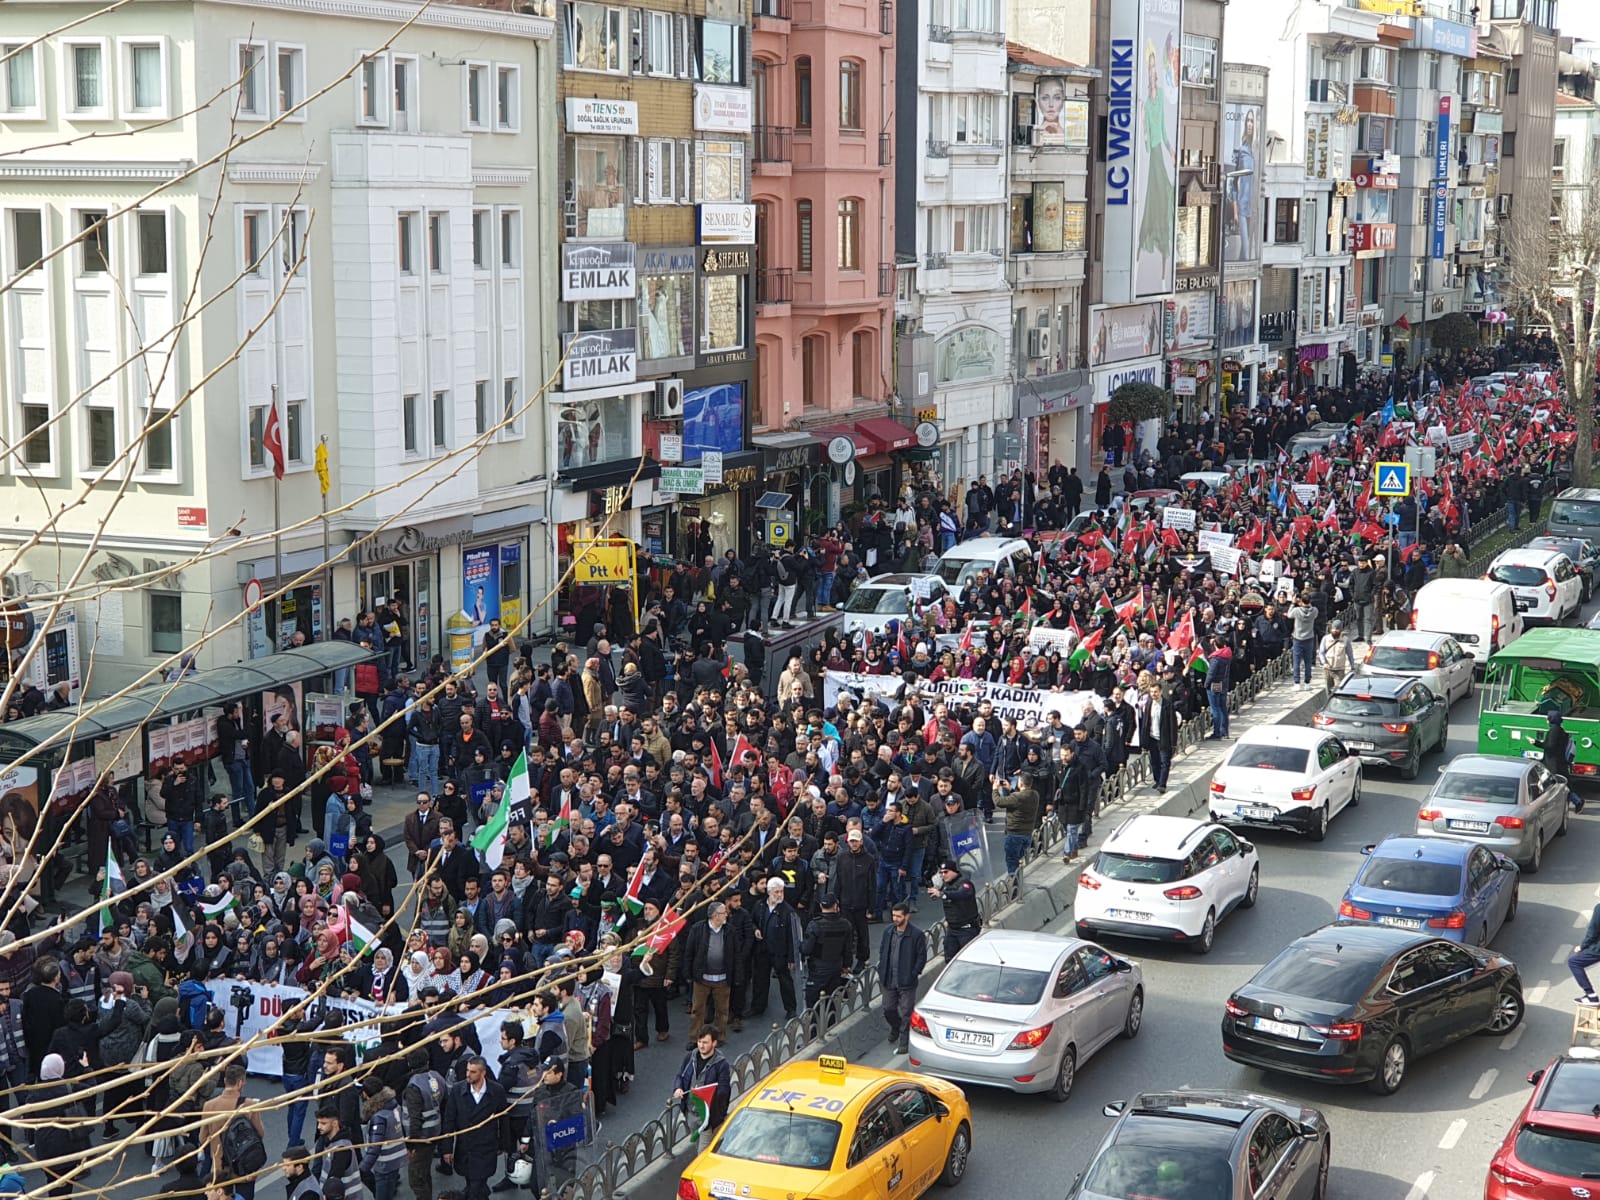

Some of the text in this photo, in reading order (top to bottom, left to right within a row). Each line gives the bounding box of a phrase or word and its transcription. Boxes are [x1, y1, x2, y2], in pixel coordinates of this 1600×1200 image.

[592, 103, 618, 114] TIENS
[1107, 166, 1129, 205] LC
[705, 212, 741, 226] SENABEL
[670, 254, 694, 270] MODA
[719, 251, 750, 269] SHEIKHA
[569, 270, 630, 289] EMLAK
[570, 355, 630, 378] EMLAK
[663, 479, 675, 487] HAC
[590, 565, 609, 578] Ptt
[962, 1033, 970, 1041] JY
[973, 1034, 991, 1043] 7794
[759, 1089, 844, 1112] TJF 20
